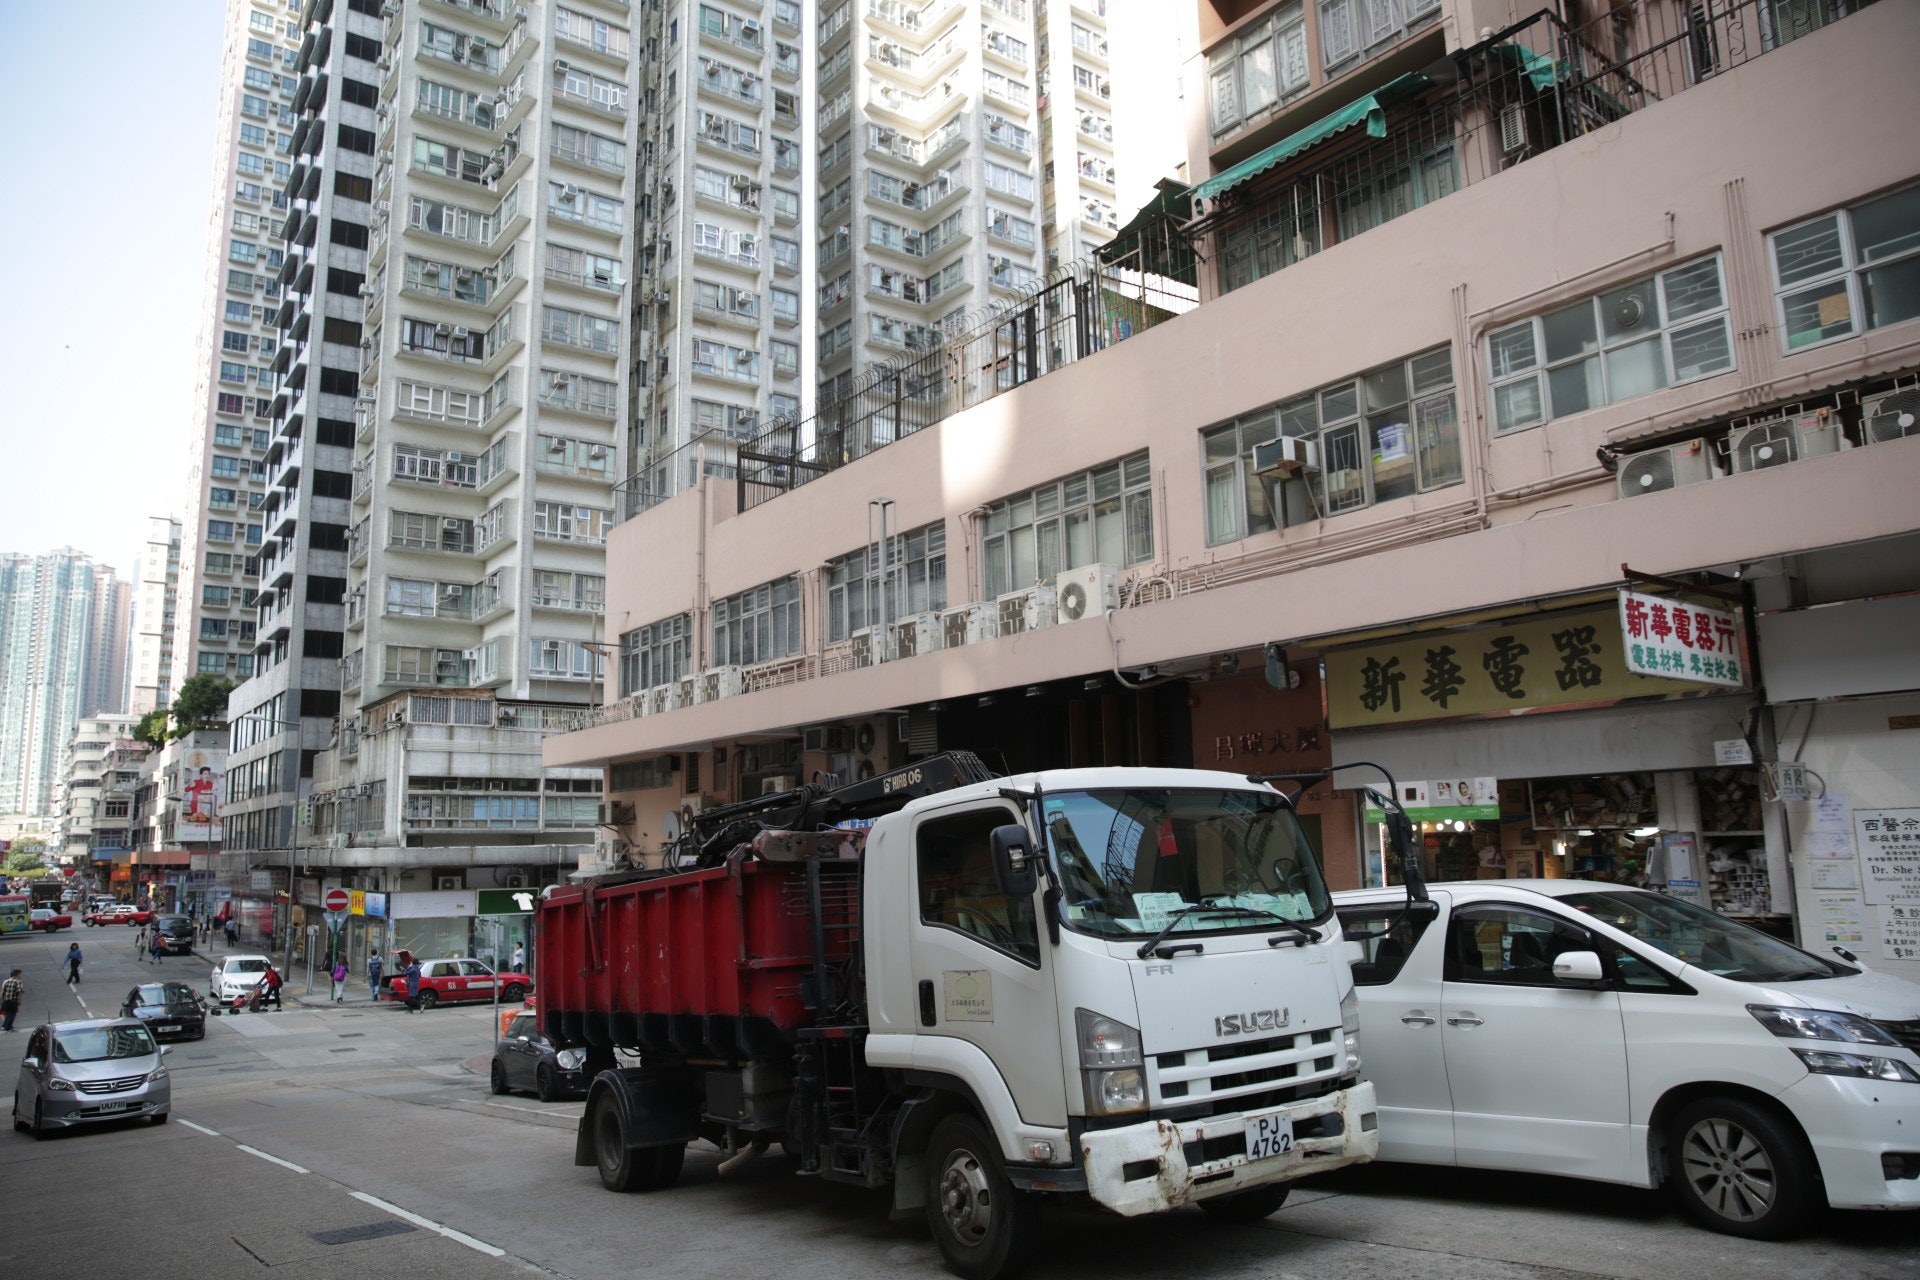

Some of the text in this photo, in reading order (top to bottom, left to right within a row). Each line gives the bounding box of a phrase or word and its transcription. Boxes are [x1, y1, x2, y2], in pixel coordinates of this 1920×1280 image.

[1625, 598, 1735, 655] 新華電器行
[1360, 625, 1645, 713] 新華電器
[1631, 644, 1685, 674] 電器材料
[892, 769, 922, 790] HIAB 06
[1871, 865, 1914, 875] Dr. She
[1885, 929, 1920, 937] 下午5:0
[1893, 947, 1920, 959] 電話:
[1145, 964, 1175, 977] FR
[1215, 1007, 1290, 1037] ISUZU
[101, 1100, 126, 1111] UU7111
[1259, 1116, 1279, 1138] PJ
[1252, 1133, 1291, 1159] 4762
